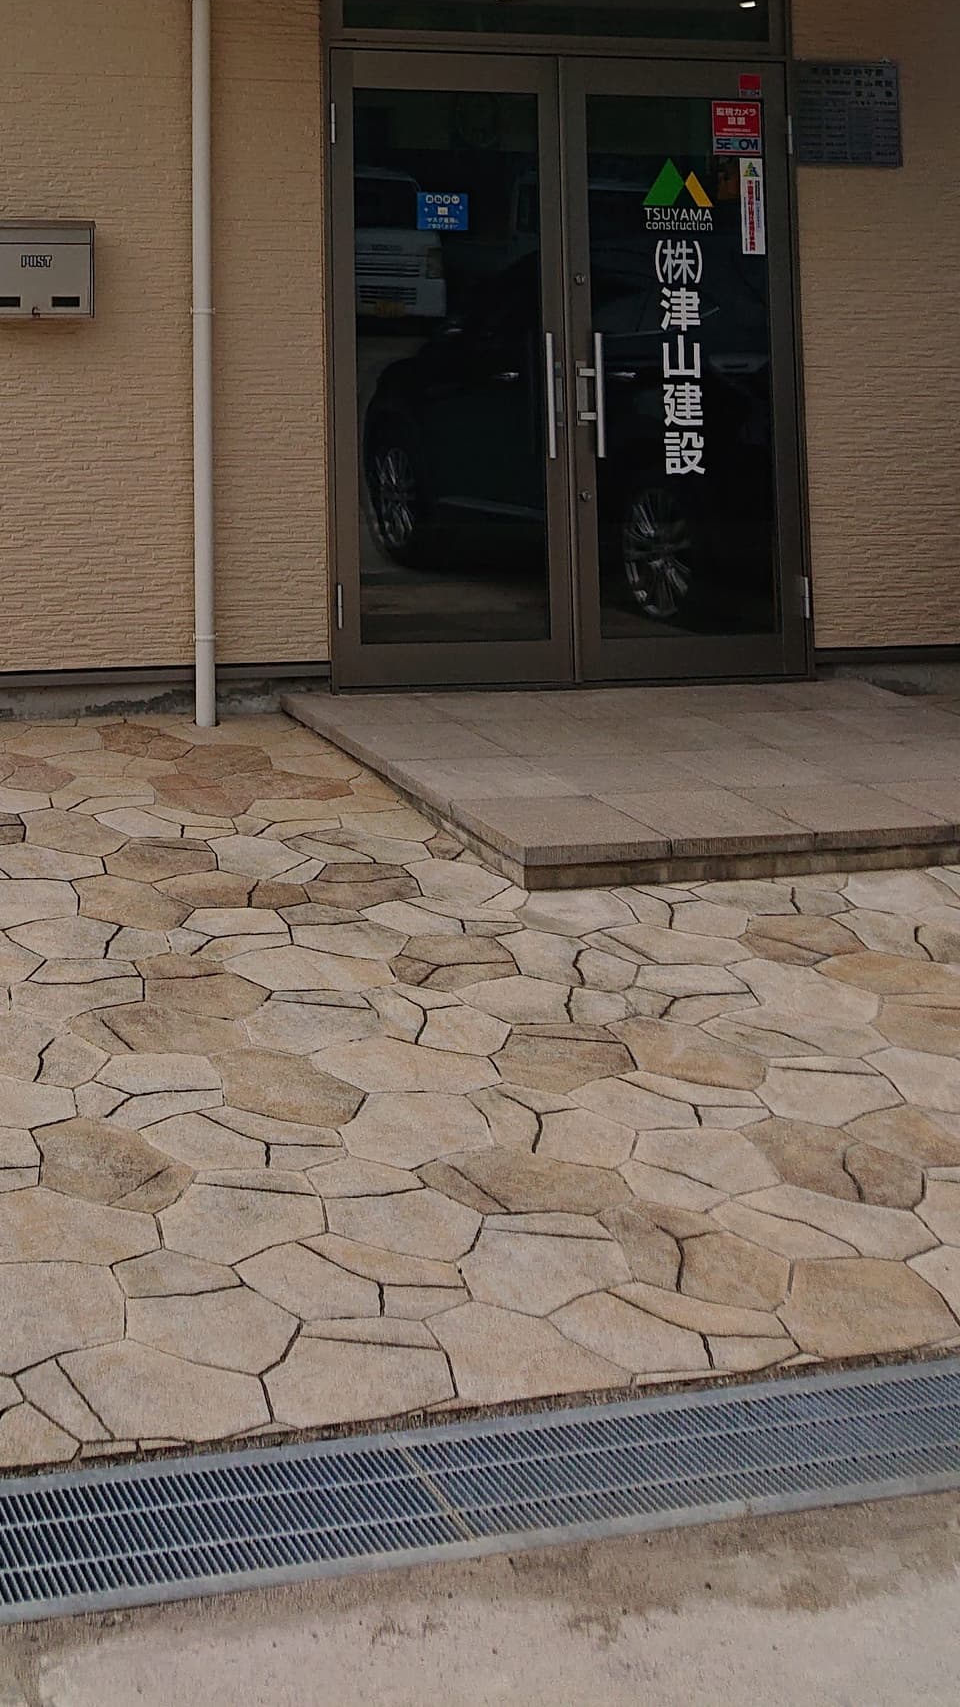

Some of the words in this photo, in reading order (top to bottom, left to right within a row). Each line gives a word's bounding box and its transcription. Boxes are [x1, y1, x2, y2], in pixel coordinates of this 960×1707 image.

[644, 207, 713, 222] TSUYAMA
[645, 220, 713, 231] construction
[20, 254, 53, 268] POST
[655, 239, 705, 475] (株)津山建設
